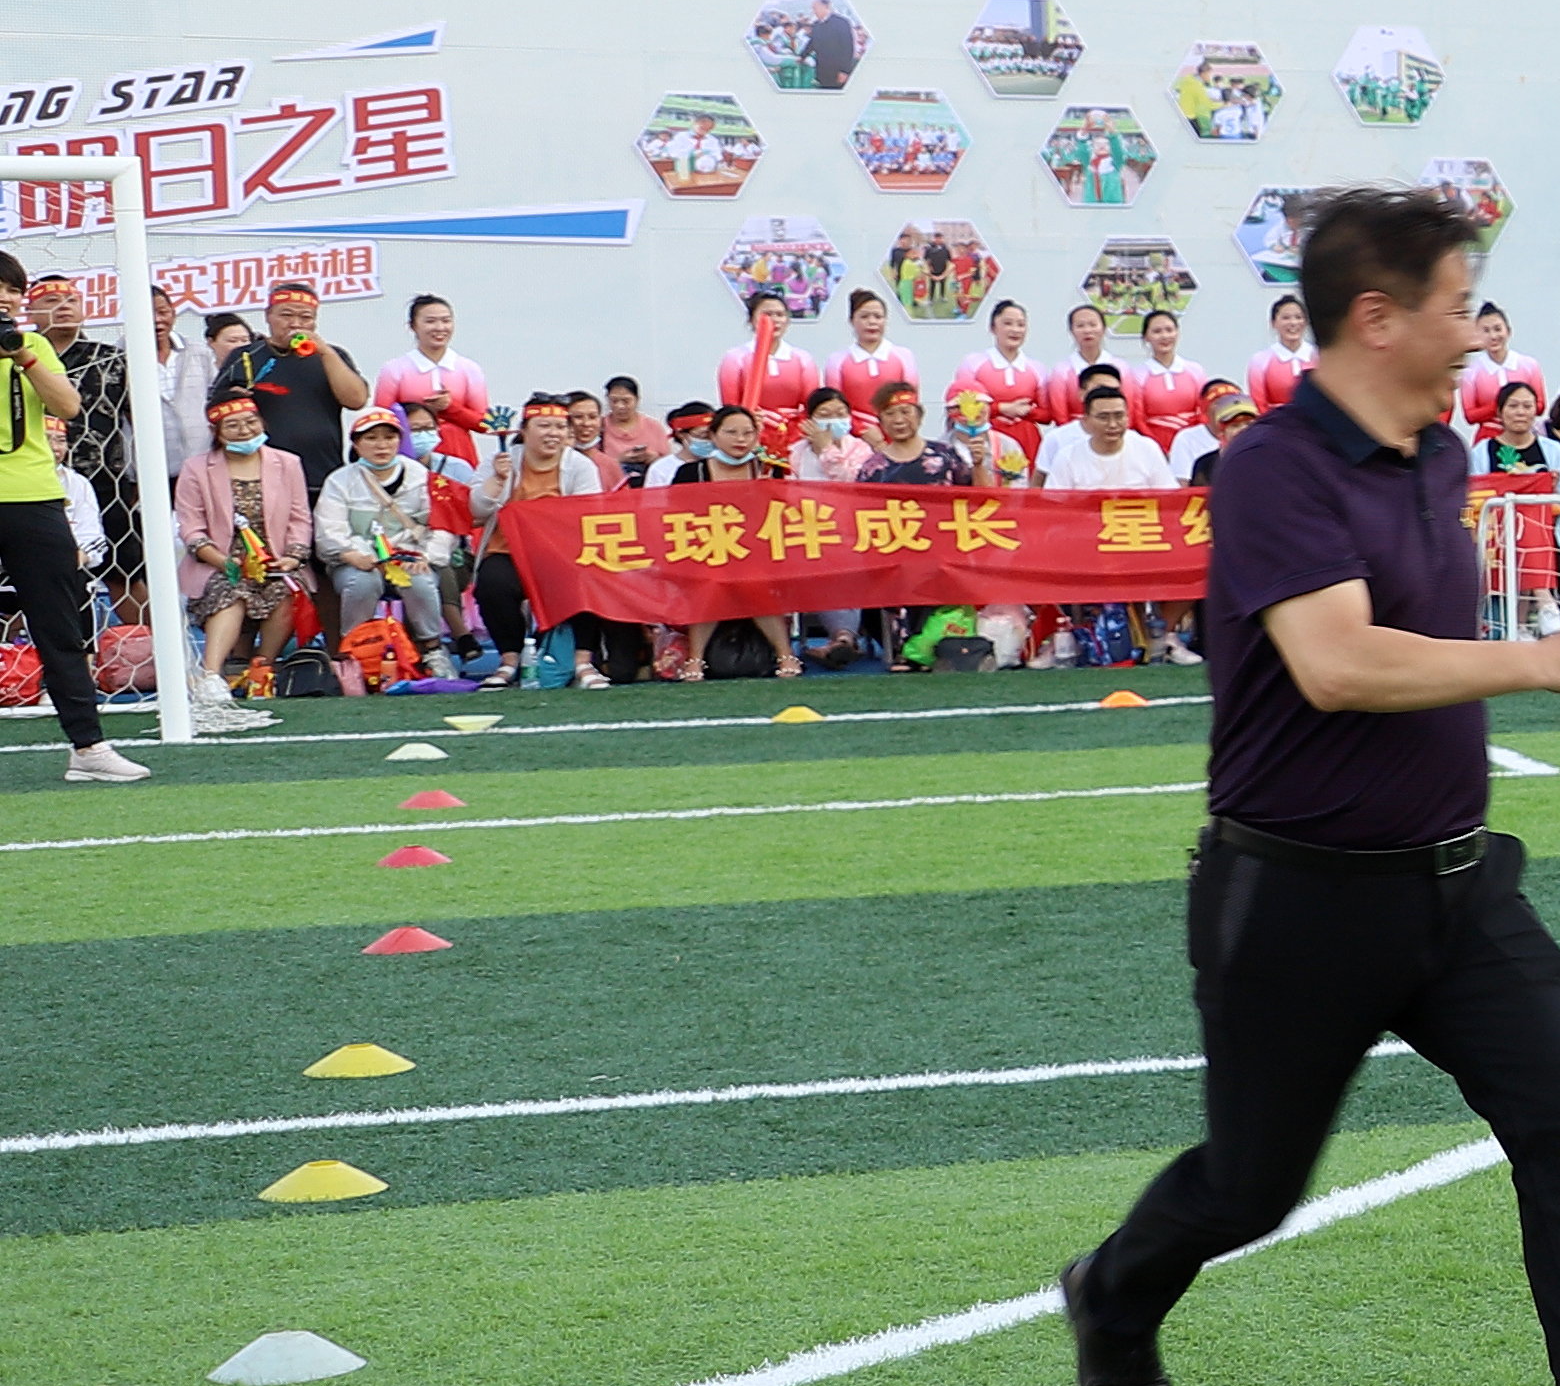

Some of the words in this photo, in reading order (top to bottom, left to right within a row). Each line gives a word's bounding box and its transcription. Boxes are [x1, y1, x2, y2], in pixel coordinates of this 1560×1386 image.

[99, 65, 244, 115] STAR
[0, 87, 449, 230] 明日之星
[576, 497, 1021, 573] 足球伴成长
